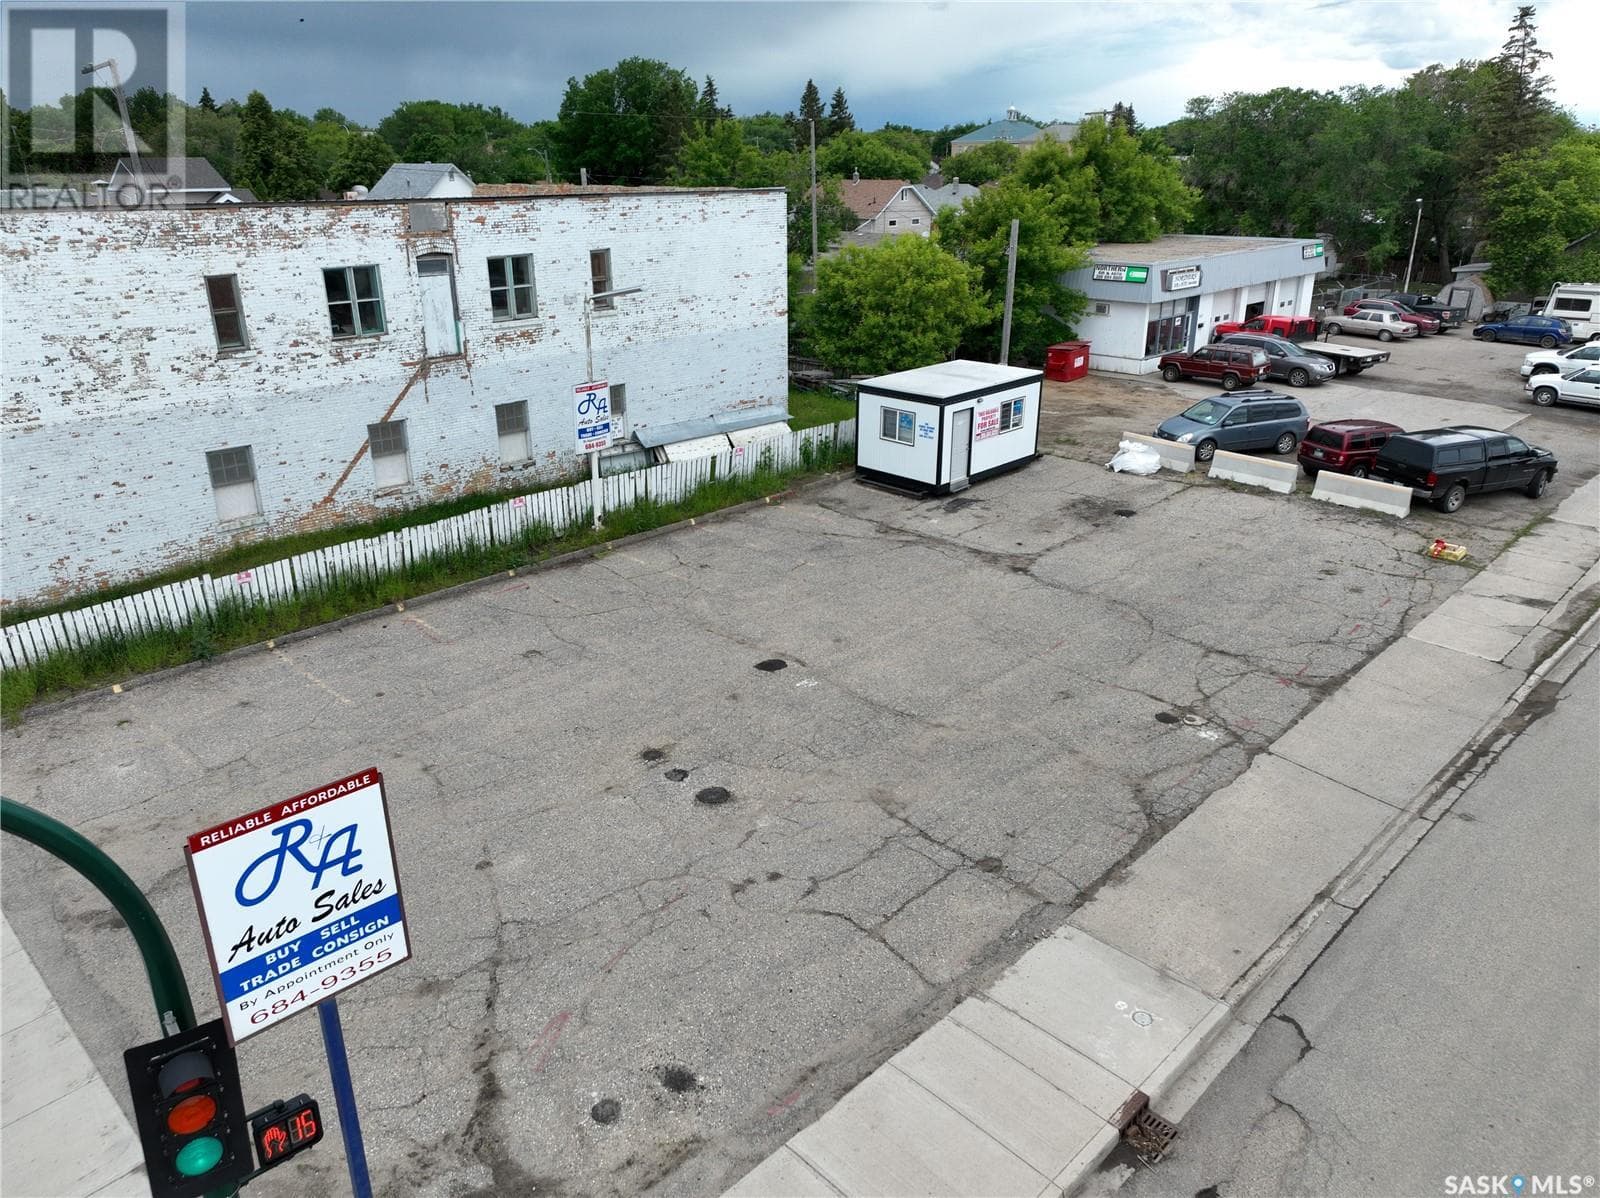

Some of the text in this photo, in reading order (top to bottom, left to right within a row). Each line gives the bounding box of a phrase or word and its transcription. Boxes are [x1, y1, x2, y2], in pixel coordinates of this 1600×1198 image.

[988, 418, 999, 427] SALE
[200, 775, 371, 847] RELIABLE AFFORDABLE
[228, 878, 387, 963] Auto Sales
[239, 916, 390, 992] TRADE CONSIGN
[265, 913, 360, 965] BUY SELL
[239, 933, 394, 1011] By Appointment Only
[250, 948, 393, 1025] 684-9355
[295, 1109, 316, 1139] 15
